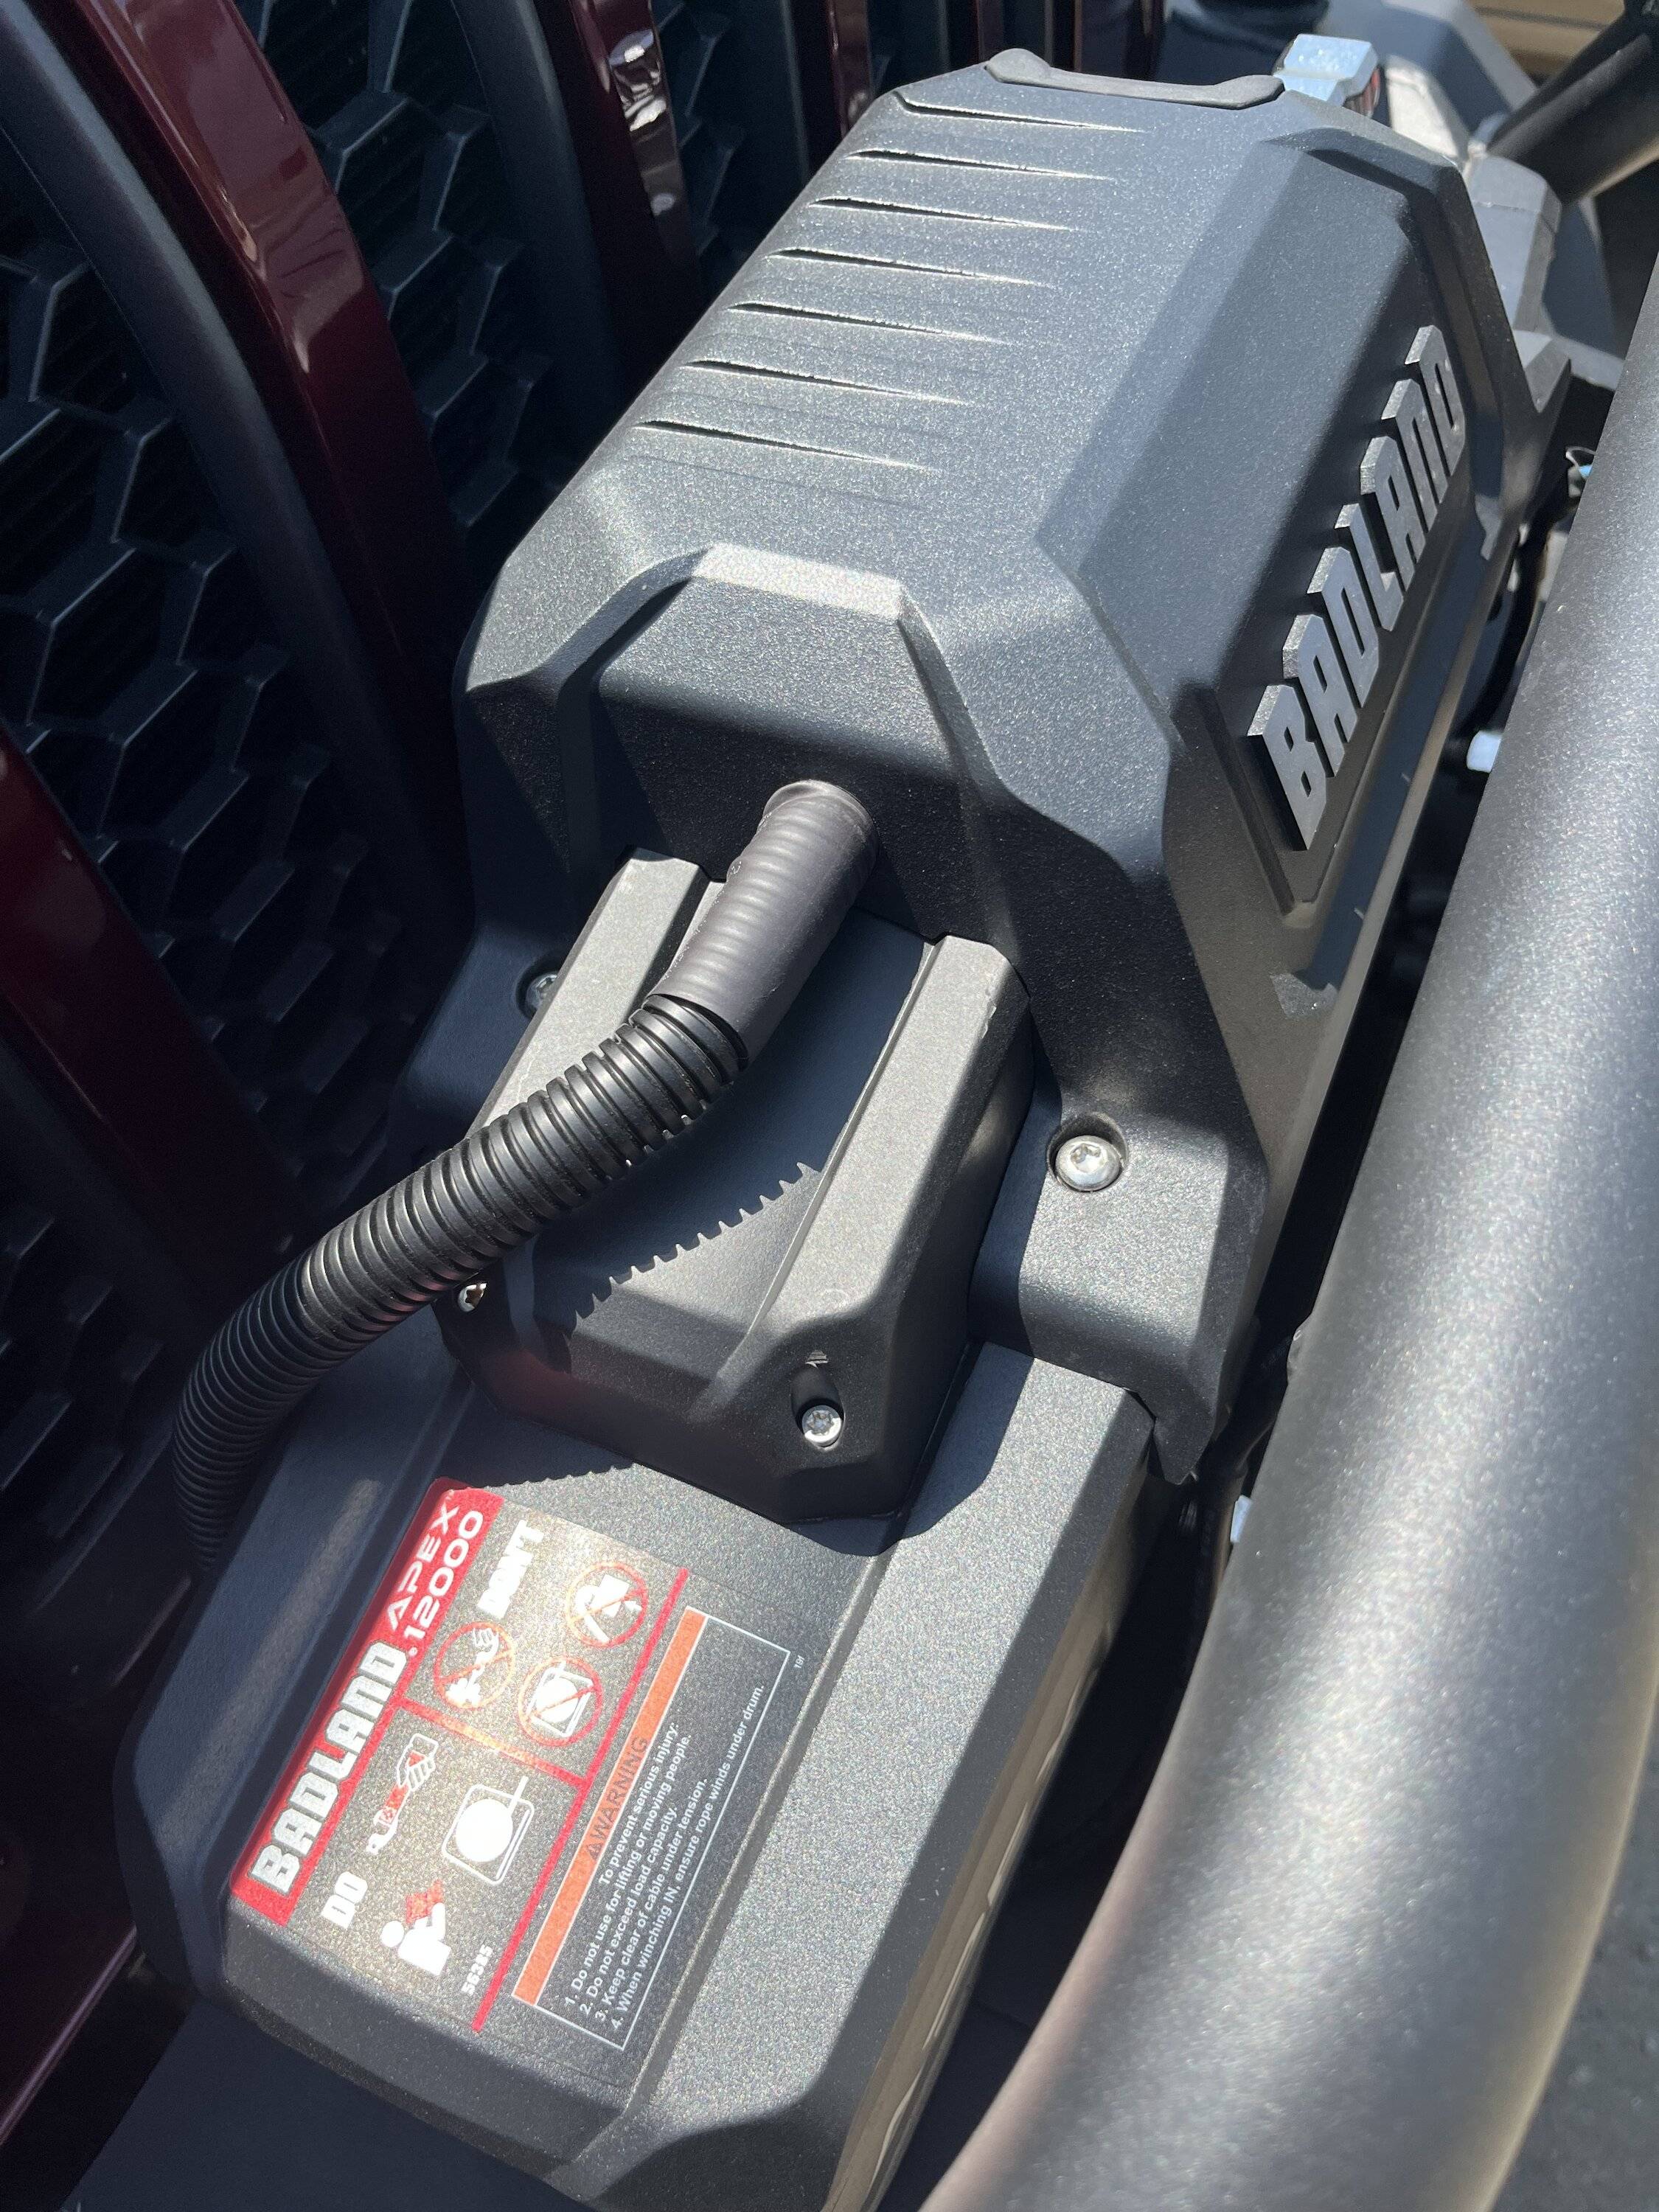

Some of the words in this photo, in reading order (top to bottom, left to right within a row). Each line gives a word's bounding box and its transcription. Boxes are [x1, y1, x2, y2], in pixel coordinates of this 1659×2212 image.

[1248, 325, 1465, 850] BADLAND
[379, 1498, 459, 1632] APEX
[402, 1506, 487, 1644] 12000
[248, 1637, 410, 1894] BADLAND
[662, 1731, 693, 1781] people.
[589, 1734, 650, 1843] WARNING
[599, 1867, 615, 1886] To
[607, 1813, 640, 1868] prevent
[630, 1763, 660, 1814] serious
[653, 1720, 681, 1764] injury:
[640, 1780, 672, 1832] moving
[676, 1775, 708, 1830] tension.
[635, 1832, 648, 1848] or
[644, 1804, 680, 1865] capacity.
[658, 1829, 684, 1871] under
[608, 2014, 624, 2030] 4.
[616, 1969, 643, 2013] When
[635, 1903, 672, 1969] winching
[662, 1882, 681, 1904] IN,
[674, 1834, 700, 1882] ensure
[694, 1801, 716, 1834] rope
[706, 1760, 731, 1801] winds
[723, 1719, 748, 1760] under
[740, 1682, 764, 1721] drum.
[614, 1848, 642, 1891] lifting
[319, 1869, 371, 1929] DO
[630, 1863, 652, 1896] load
[641, 1871, 667, 1911] cable
[605, 1888, 623, 1913] for
[633, 1910, 650, 1929] of
[594, 1913, 612, 1941] use
[607, 1896, 638, 1948] exceed
[582, 1941, 600, 1965] not
[597, 1948, 616, 1975] not
[618, 1928, 642, 1966] clear
[563, 1991, 578, 2007] 1.
[570, 1967, 588, 1991] Do
[585, 1975, 604, 1998] Do
[601, 1966, 628, 2006] Keep
[578, 1999, 594, 2014] 2.
[594, 2006, 609, 2022] 3.
